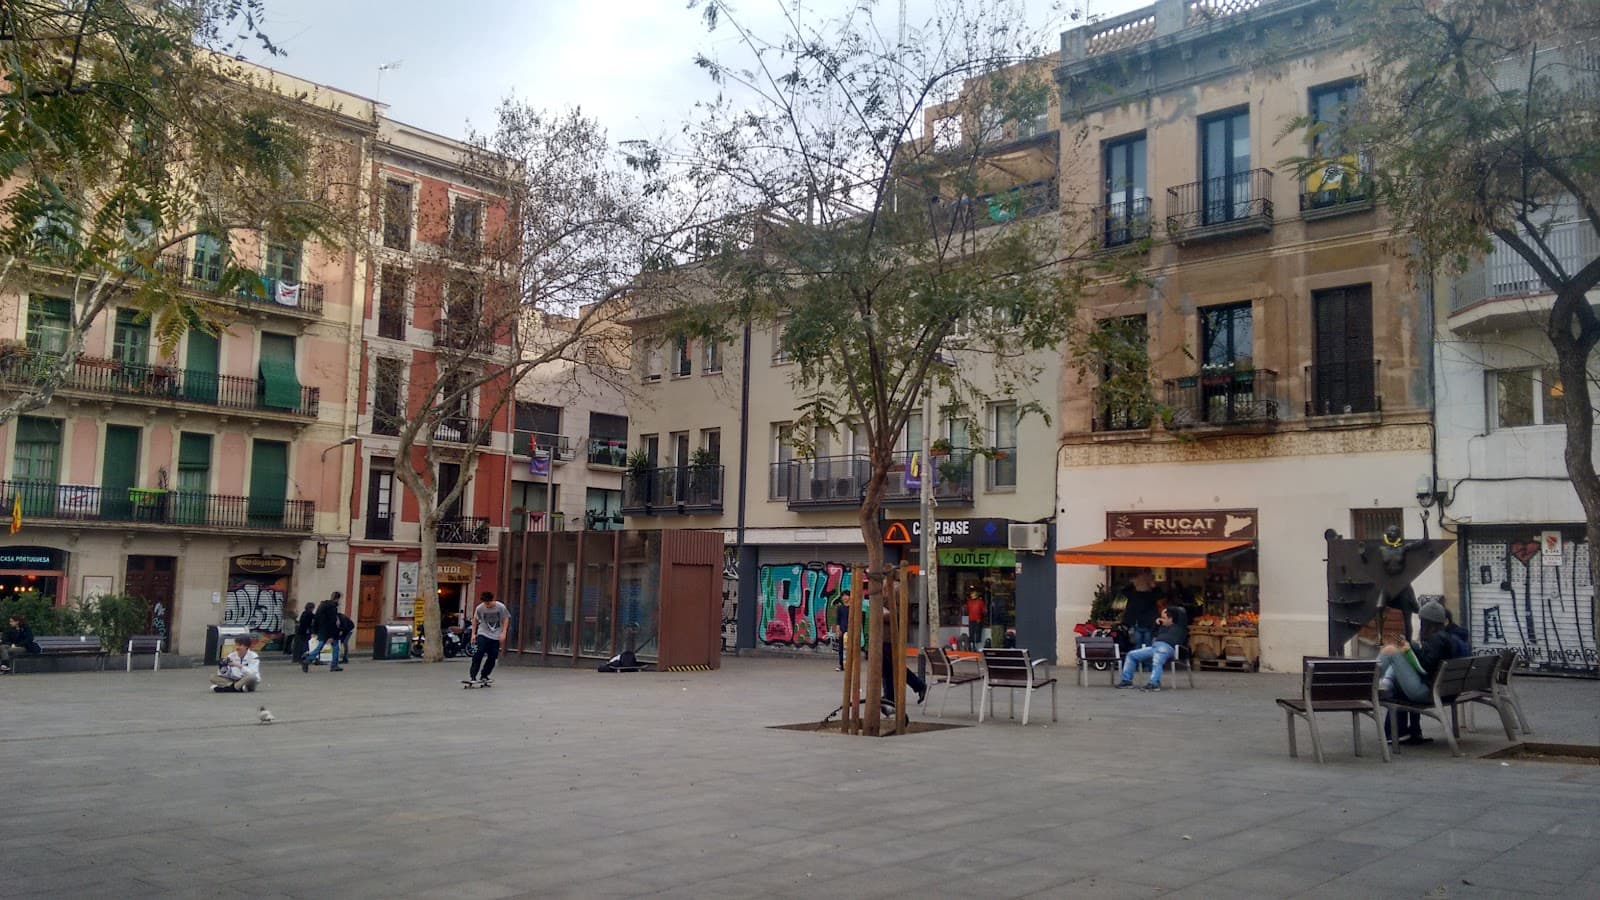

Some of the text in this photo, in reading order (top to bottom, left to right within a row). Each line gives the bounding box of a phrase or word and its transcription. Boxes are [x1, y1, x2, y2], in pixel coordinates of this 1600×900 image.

[912, 520, 969, 535] CP BASE
[1143, 518, 1216, 530] FRUCAT
[953, 553, 991, 565] OUTLET
